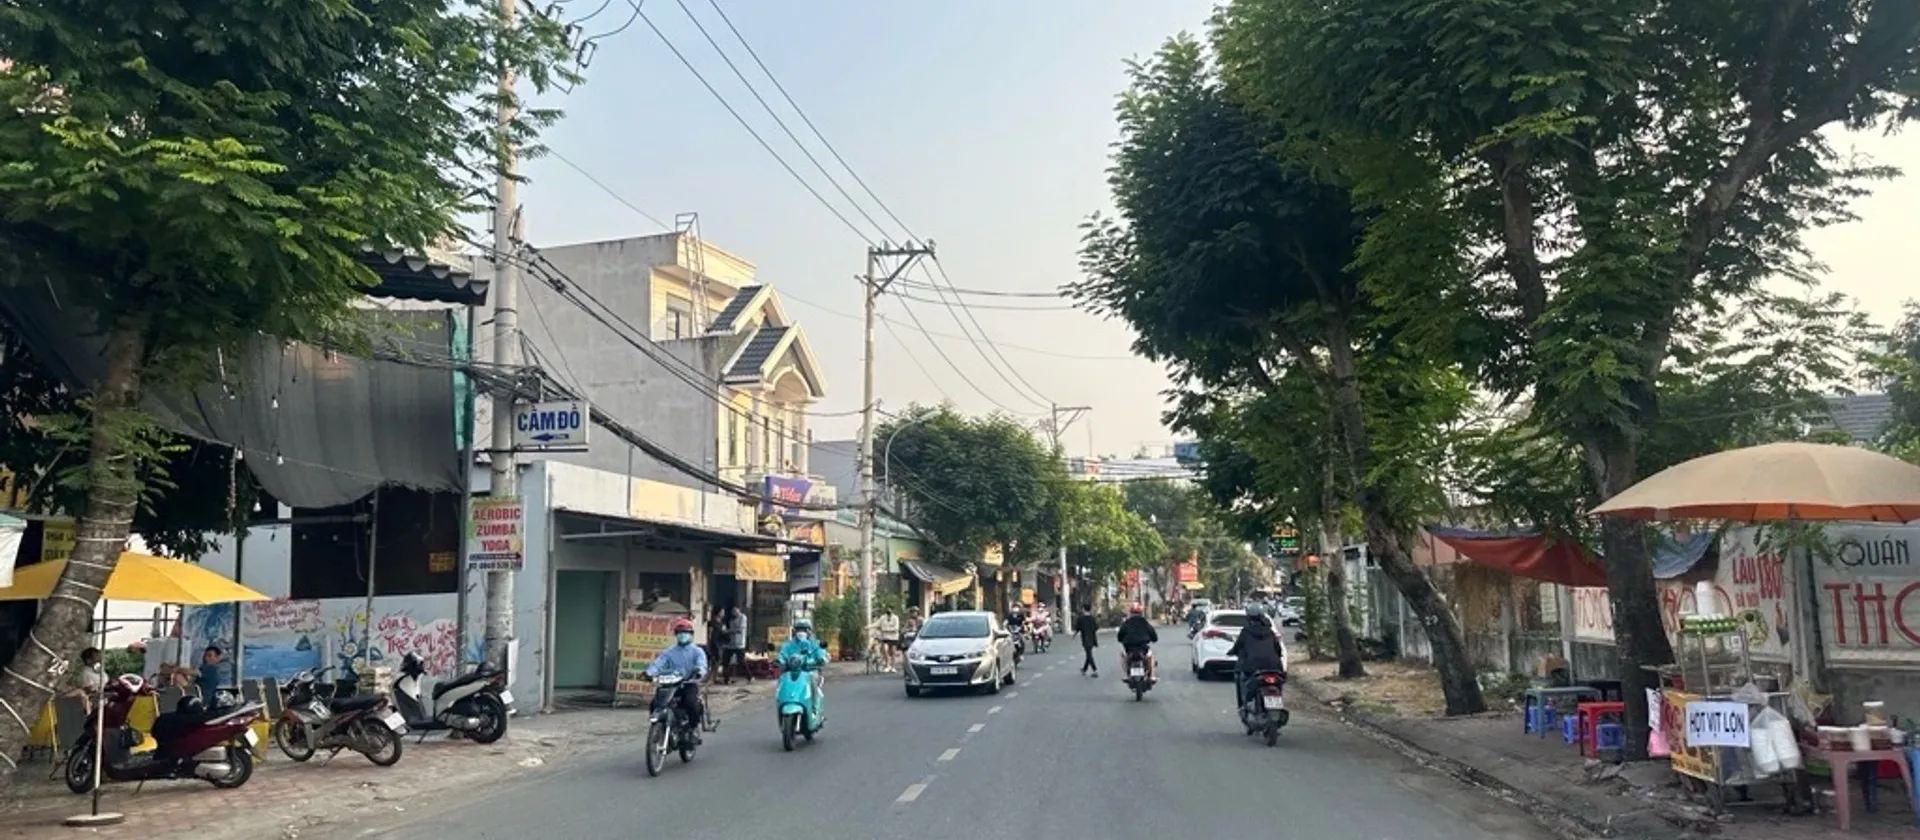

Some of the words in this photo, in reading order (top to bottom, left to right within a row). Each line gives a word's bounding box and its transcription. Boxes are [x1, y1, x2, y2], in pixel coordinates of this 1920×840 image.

[473, 508, 521, 520] AEROBIC
[477, 524, 517, 536] ZUMBA
[482, 540, 510, 551] YOGA
[1839, 535, 1910, 567] QUÁN
